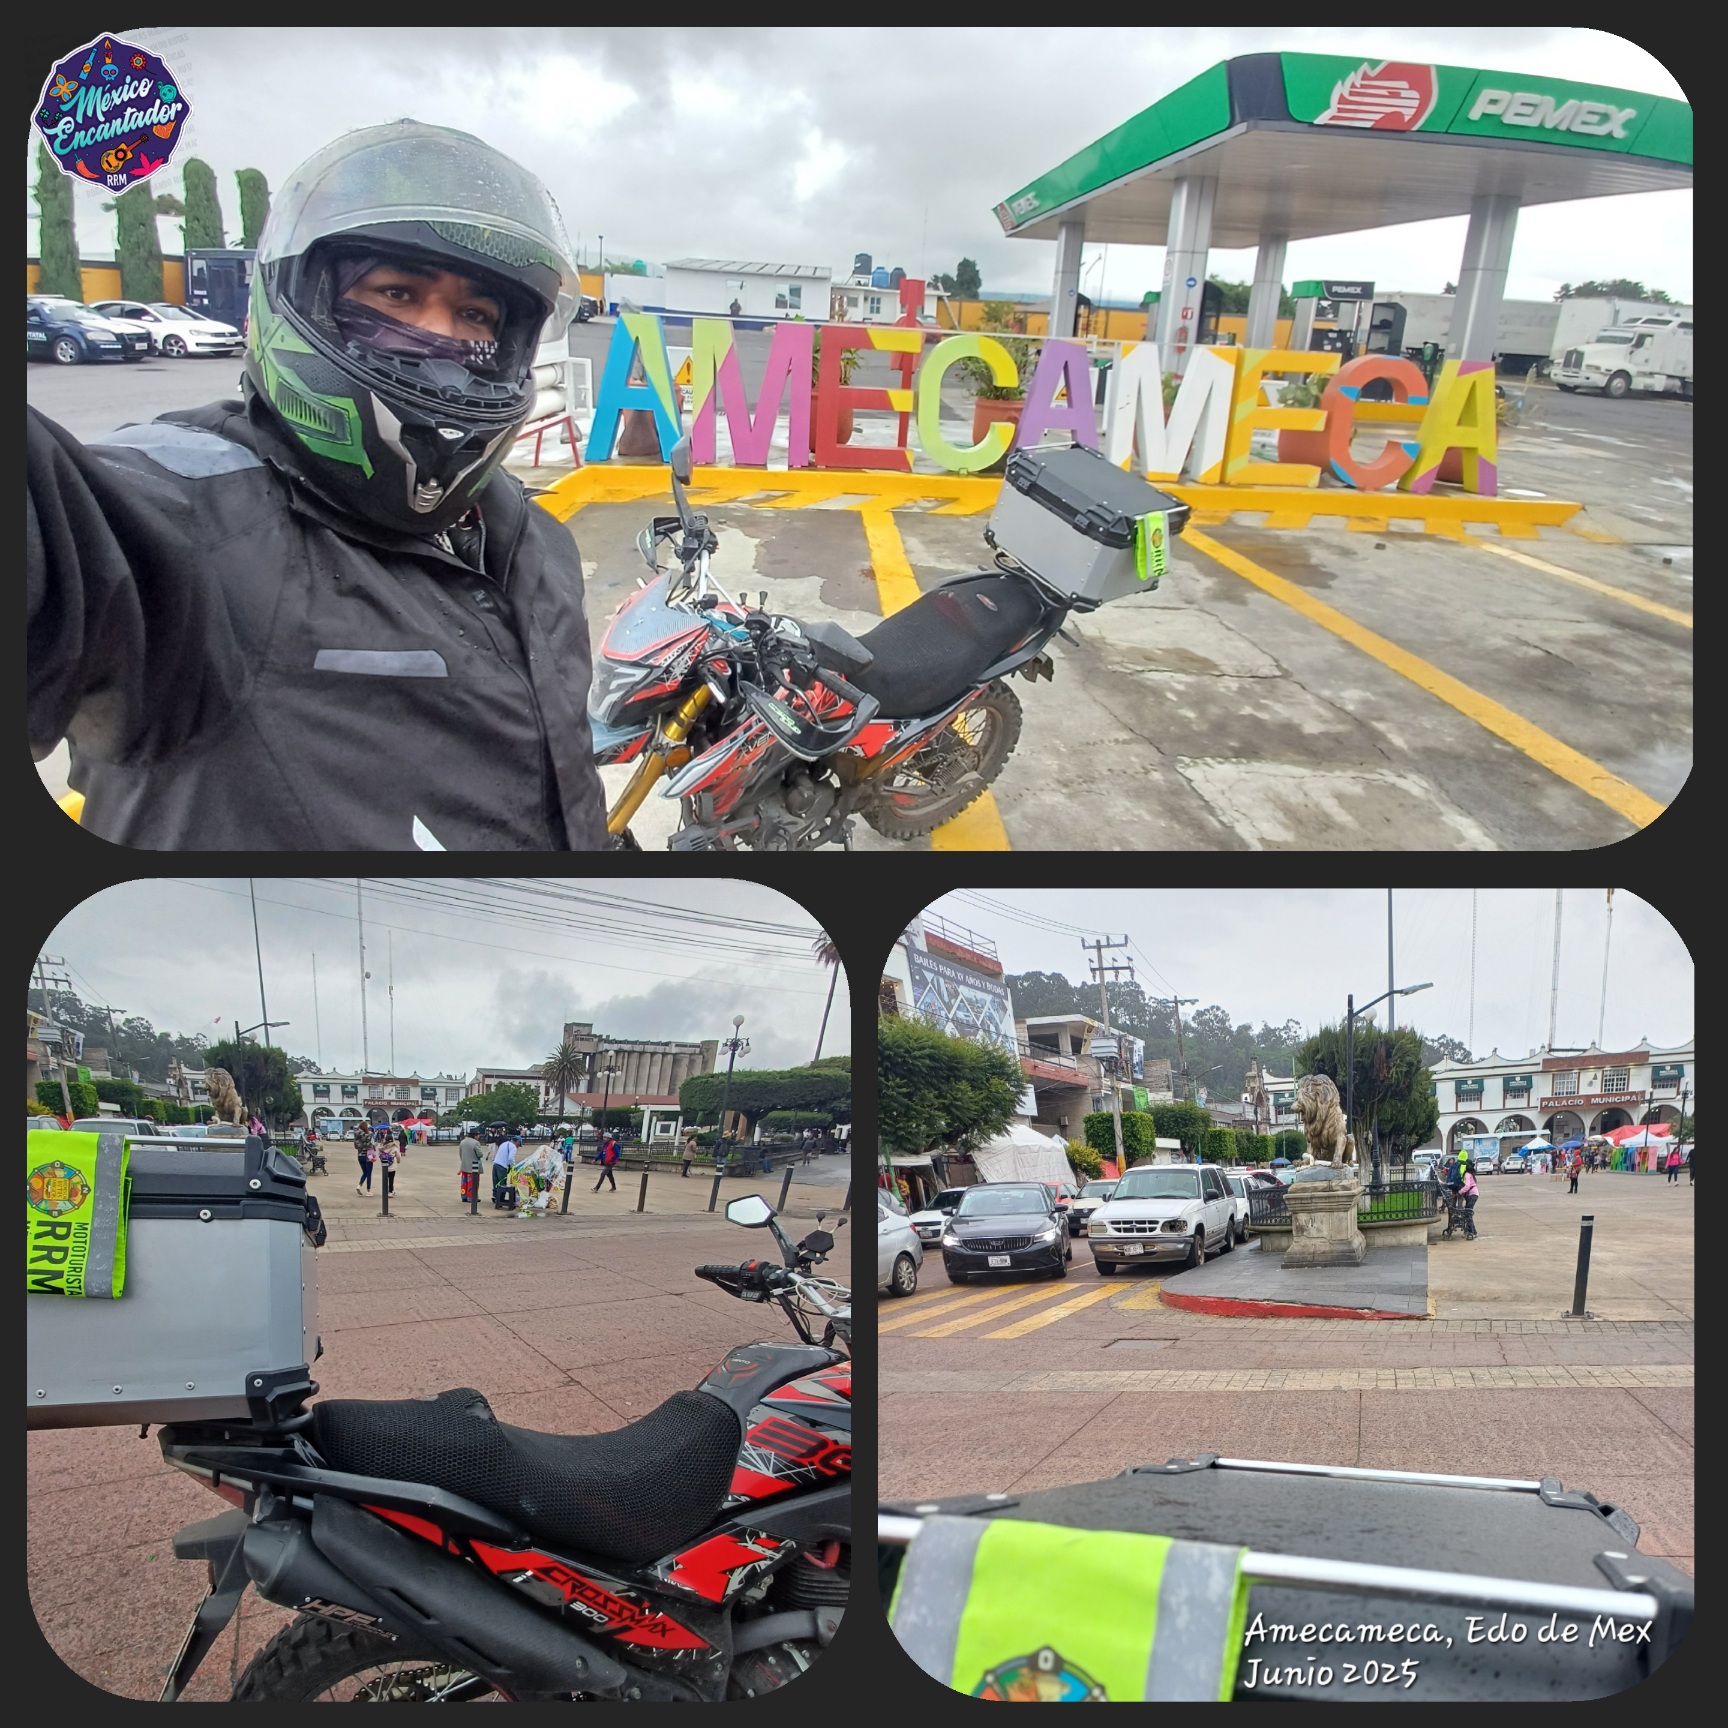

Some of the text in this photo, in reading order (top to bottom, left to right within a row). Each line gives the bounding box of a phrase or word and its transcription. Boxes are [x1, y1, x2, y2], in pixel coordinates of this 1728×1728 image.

[1467, 89, 1637, 139] PEMEX
[1331, 286, 1363, 294] PEMEX
[586, 313, 1499, 495] AMECAMECA
[913, 953, 938, 971] BAILES
[939, 964, 956, 978] PARA
[956, 971, 965, 981] XV
[965, 974, 981, 988] AÑOS
[986, 982, 1005, 996] BODAS
[1541, 1098, 1584, 1108] PALACIO
[27, 1220, 72, 1295] RRM
[66, 1222, 90, 1296] MOTOTURISTA
[546, 1565, 676, 1638] CROSSMAX
[569, 1601, 609, 1624] 300
